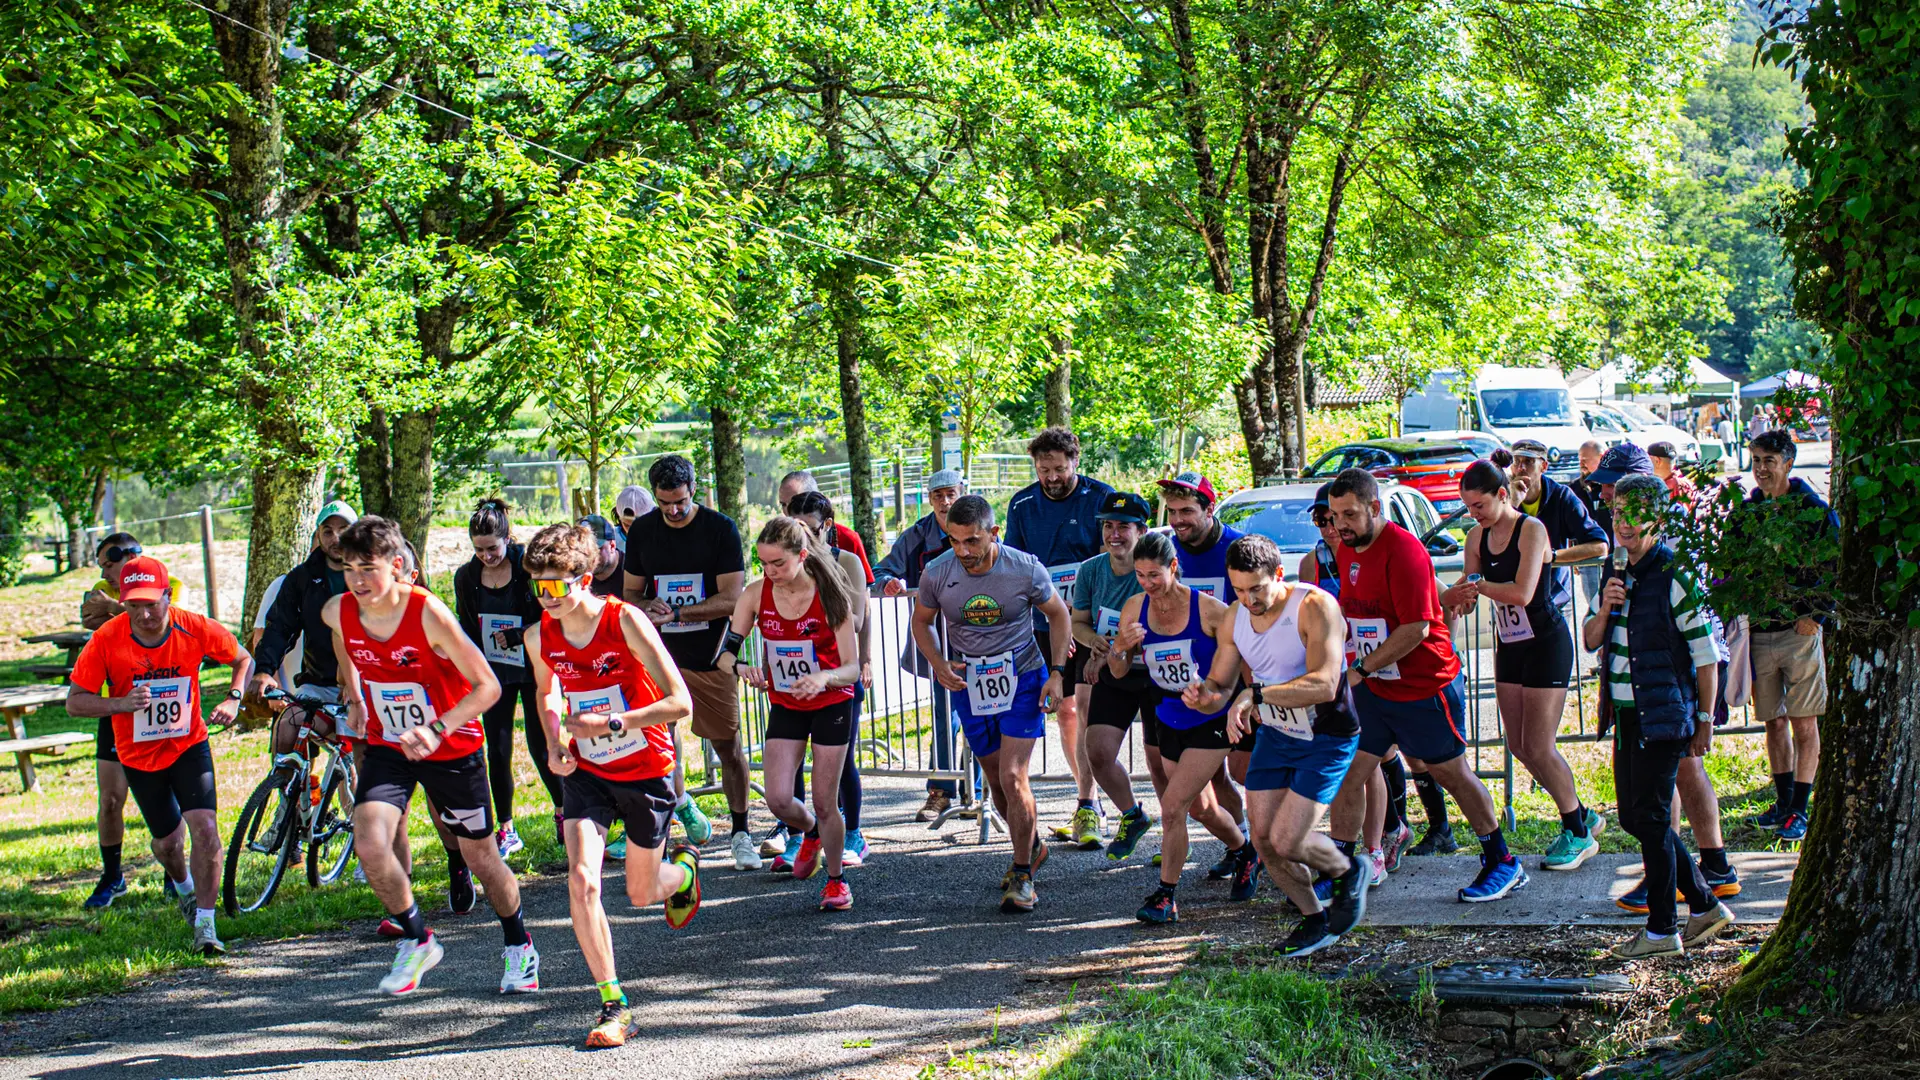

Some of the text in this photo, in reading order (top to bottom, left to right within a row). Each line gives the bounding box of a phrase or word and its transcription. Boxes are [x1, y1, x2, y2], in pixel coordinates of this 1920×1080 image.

[123, 573, 156, 584] adidas
[776, 660, 811, 680] 149
[1158, 662, 1190, 684] 186
[976, 675, 1010, 700] 180
[144, 701, 181, 726] 189
[383, 704, 425, 728] 179
[589, 740, 637, 759] Crédit Mutuel
